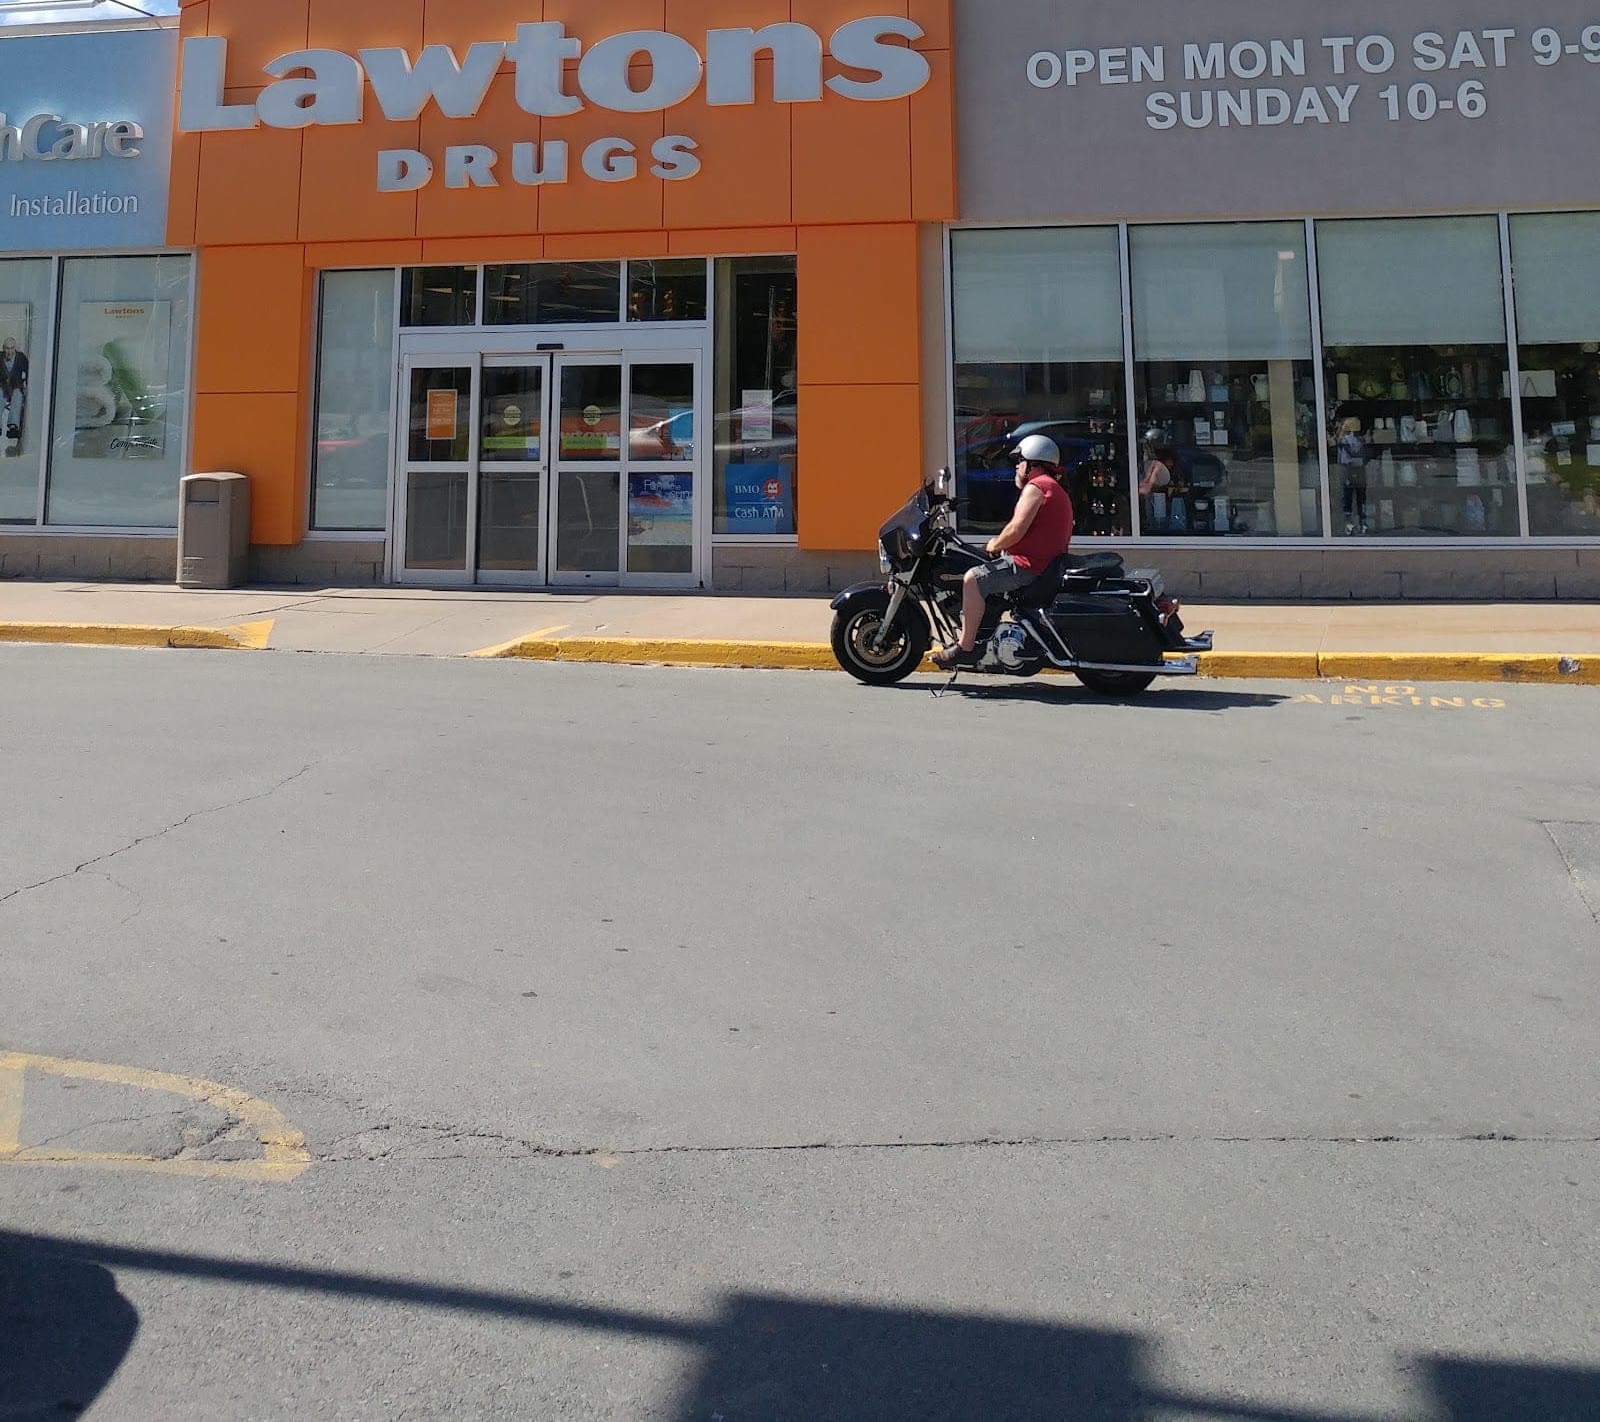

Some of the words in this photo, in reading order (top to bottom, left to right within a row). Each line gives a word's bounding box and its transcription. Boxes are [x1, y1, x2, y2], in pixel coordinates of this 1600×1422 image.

[1026, 46, 1166, 88] OPEN
[1184, 39, 1306, 80] MON
[1321, 34, 1395, 75] TO
[1412, 28, 1516, 72] SAT
[179, 15, 931, 132] Lawtons
[1145, 85, 1360, 130] SUNDAY
[1379, 80, 1488, 122] 10-6
[377, 135, 702, 192] DRUGS
[10, 190, 139, 217] Installation
[734, 484, 761, 494] BMO
[734, 506, 759, 519] Cash
[762, 506, 785, 519] ATM
[1294, 694, 1506, 708] ARKING
[1345, 685, 1416, 695] NO
